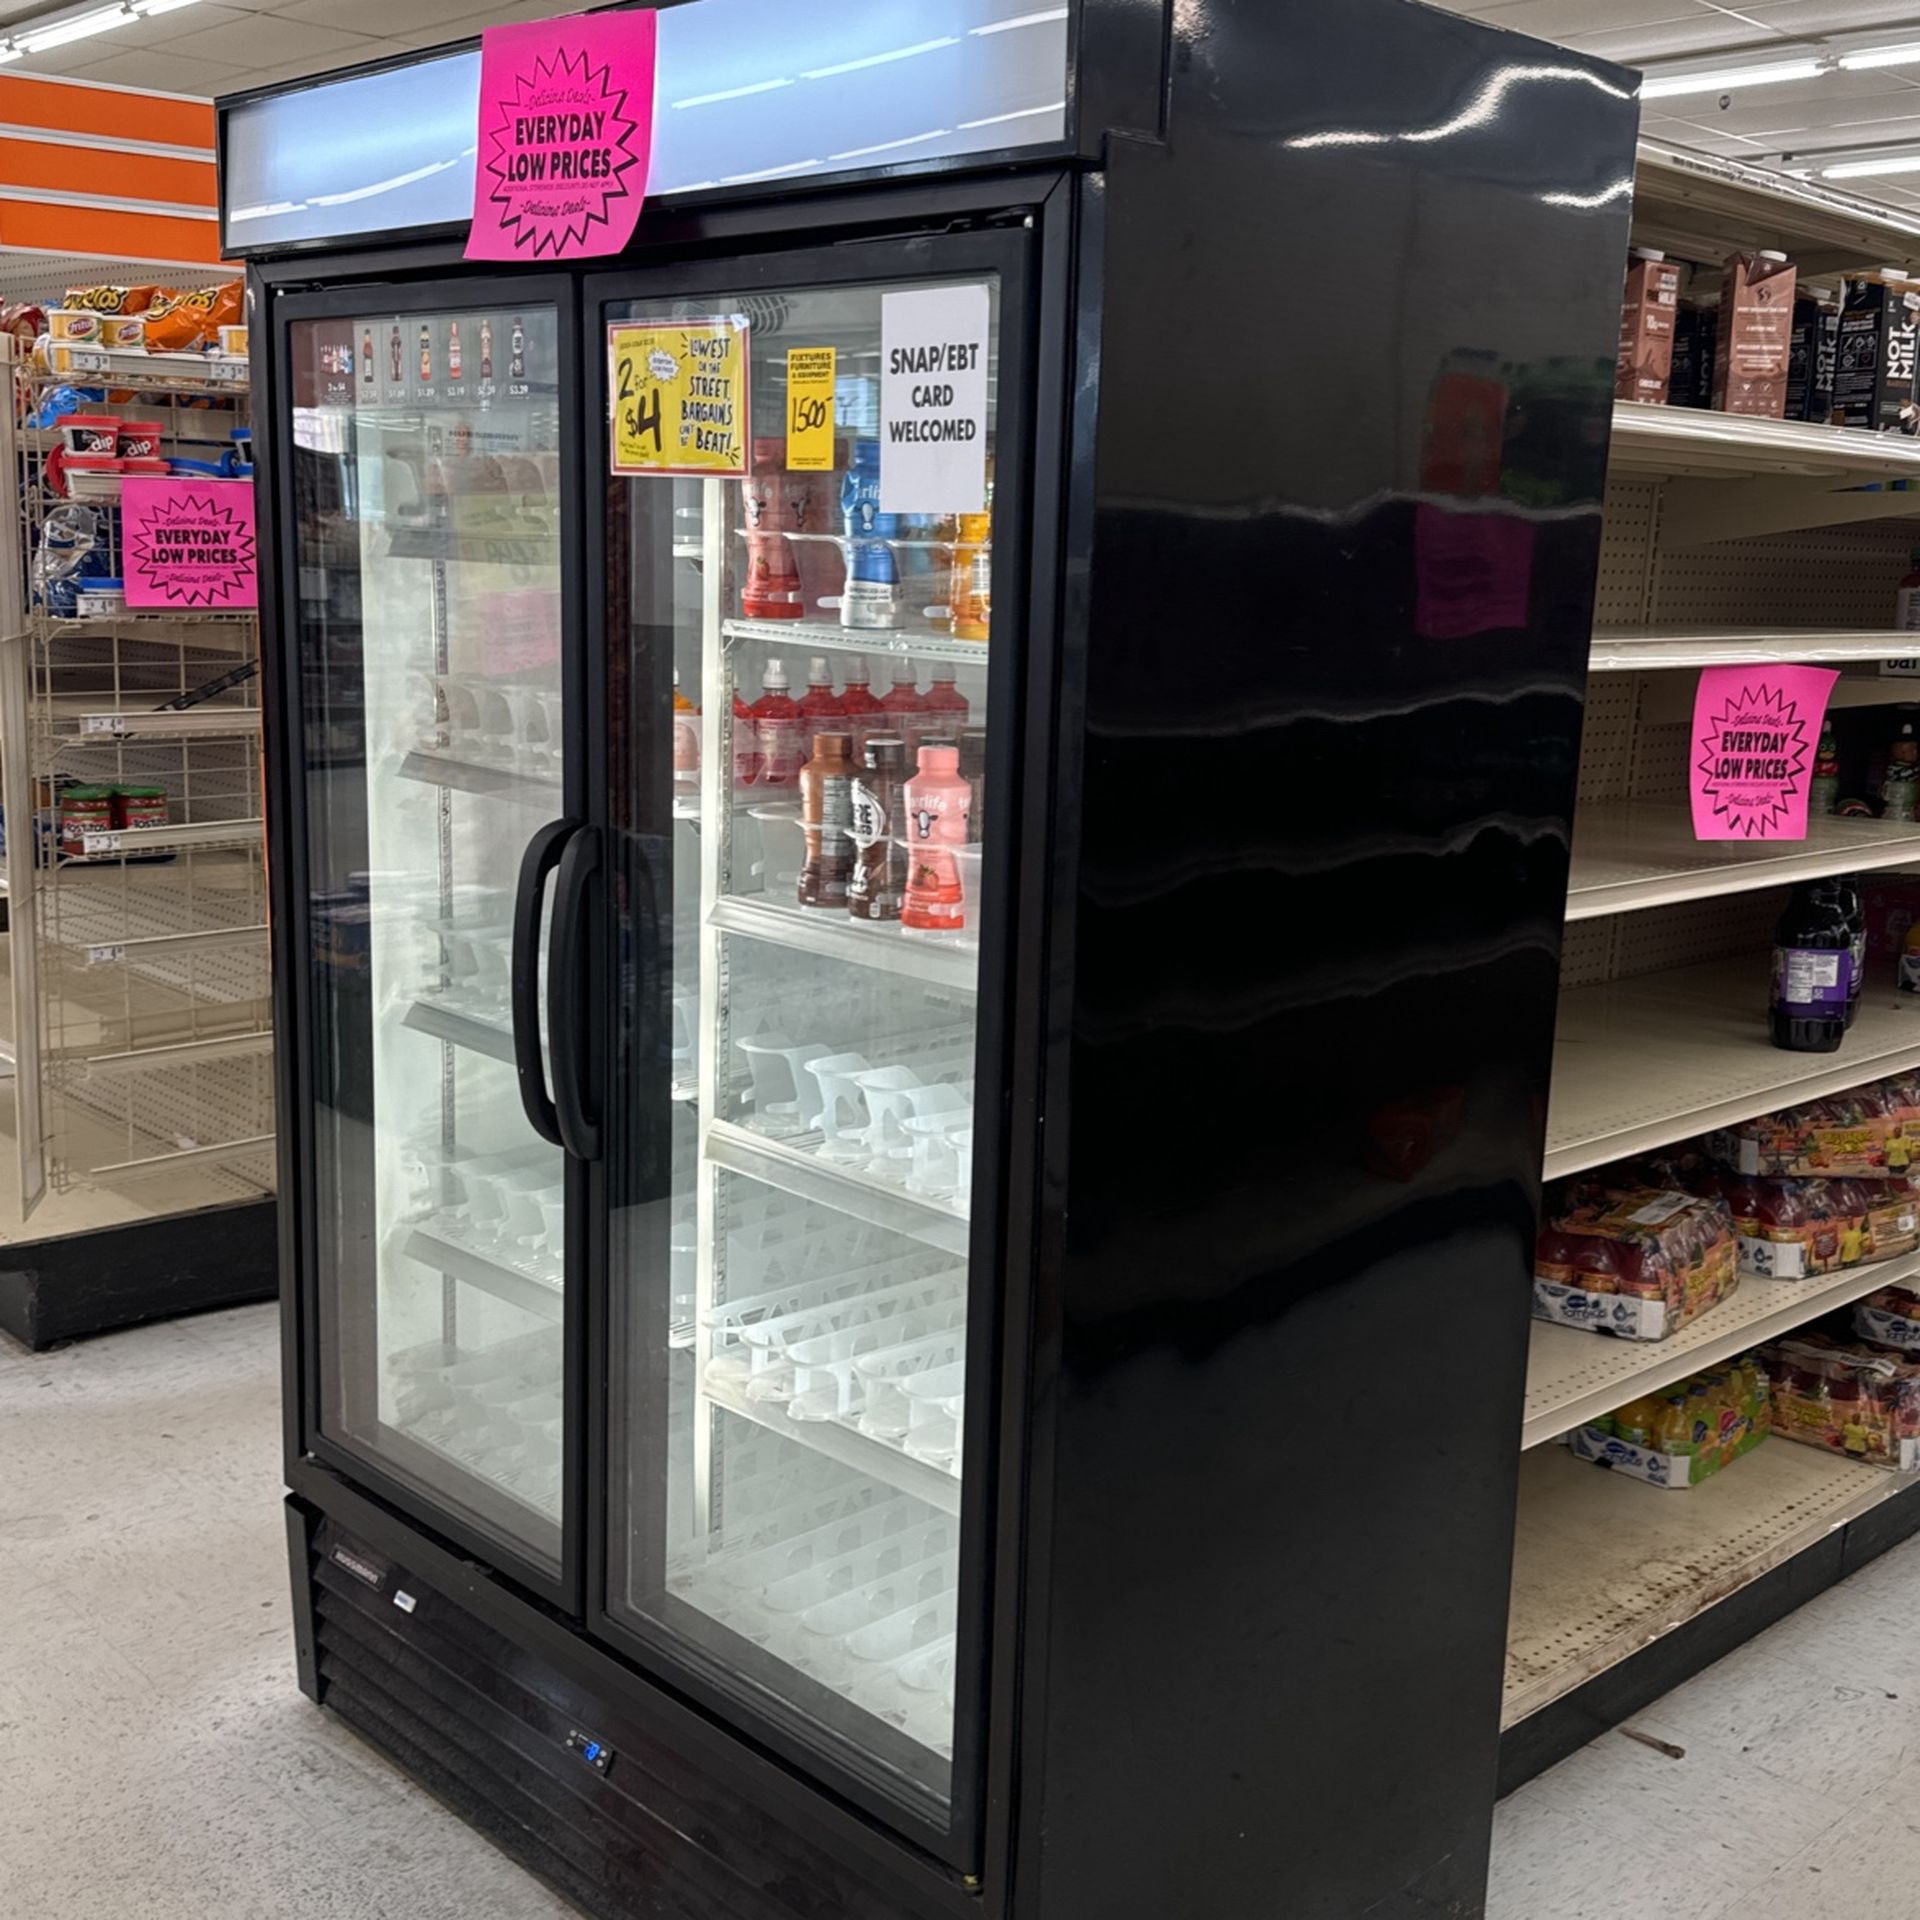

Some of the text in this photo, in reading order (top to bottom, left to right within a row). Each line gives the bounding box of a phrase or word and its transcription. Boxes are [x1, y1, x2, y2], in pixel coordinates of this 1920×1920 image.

[516, 111, 605, 146] EVERYDAY
[507, 147, 612, 182] LOW PRICES
[690, 337, 731, 359] LOWEST
[889, 343, 979, 375] SNAP/EBT
[619, 357, 635, 401] 2
[911, 384, 954, 408] CARD
[625, 388, 662, 452] $4
[681, 399, 733, 427] BARGAINS
[695, 426, 733, 457] BEAT!
[889, 418, 977, 443] WELCOMED
[90, 434, 115, 452] dip
[126, 438, 152, 457] dip
[154, 528, 231, 545] EVERYDAY
[151, 547, 238, 564] LOW PRICES
[1721, 730, 1790, 754] EVERYDAY
[1714, 757, 1790, 780] LOW PRICES
